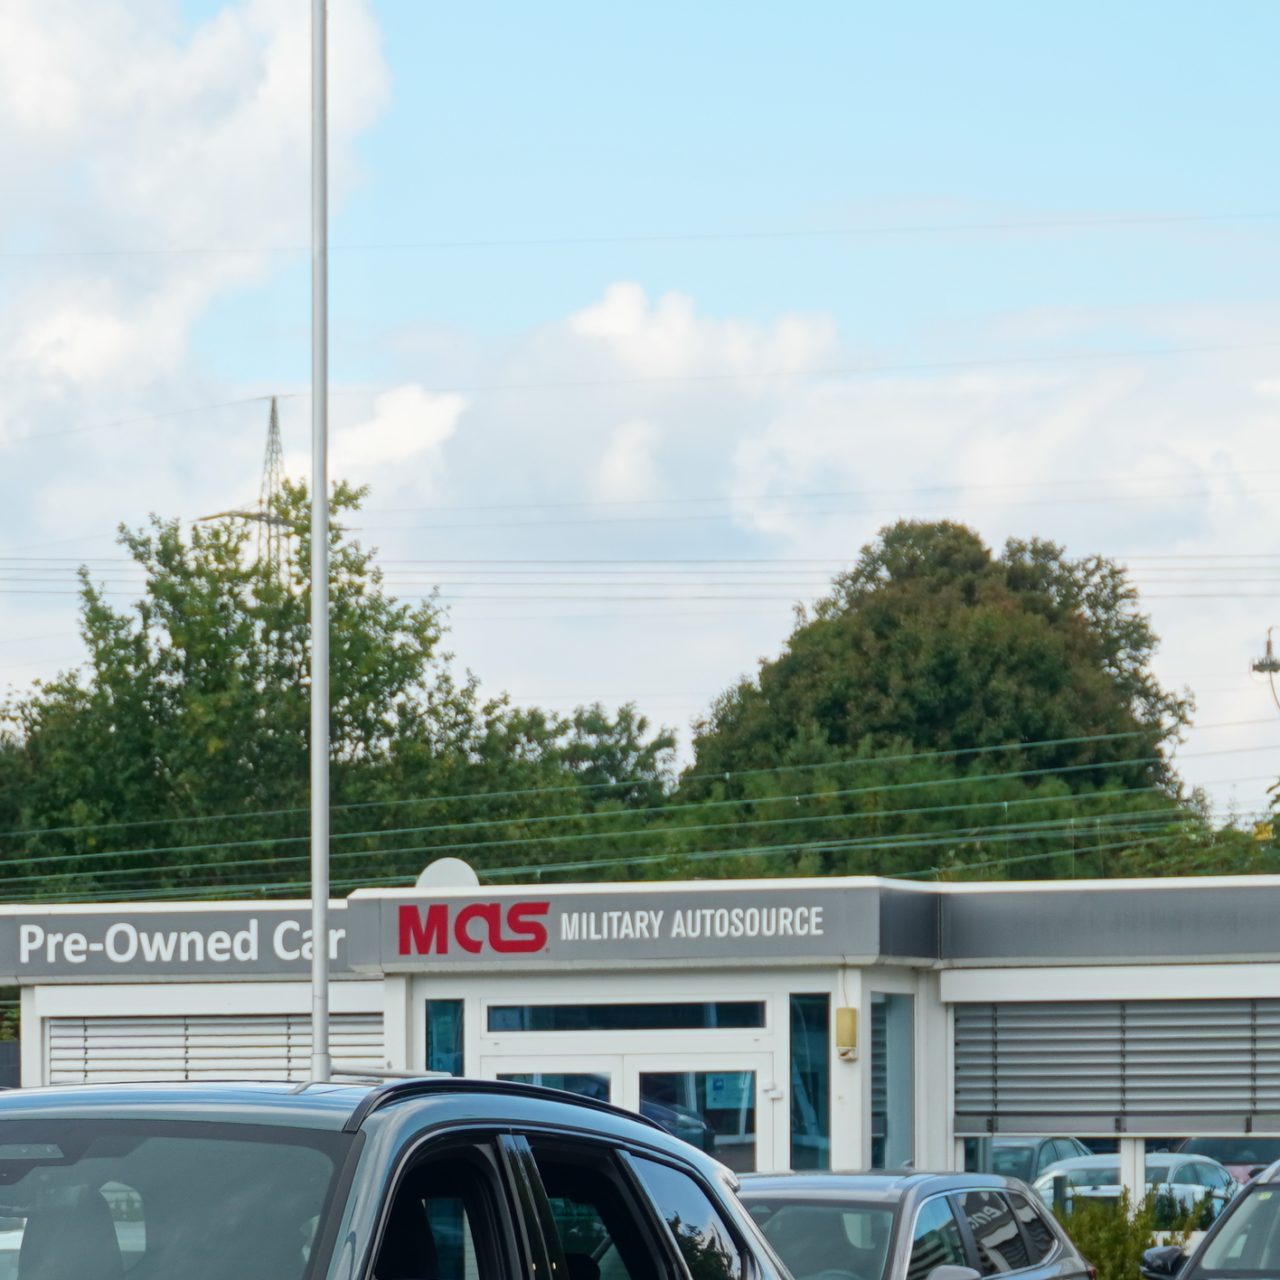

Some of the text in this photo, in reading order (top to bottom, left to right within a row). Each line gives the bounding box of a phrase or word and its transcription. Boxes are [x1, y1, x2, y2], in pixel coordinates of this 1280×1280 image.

[20, 918, 258, 964] Pre-Owned
[561, 906, 824, 941] MILITARY AUTOSOURCE
